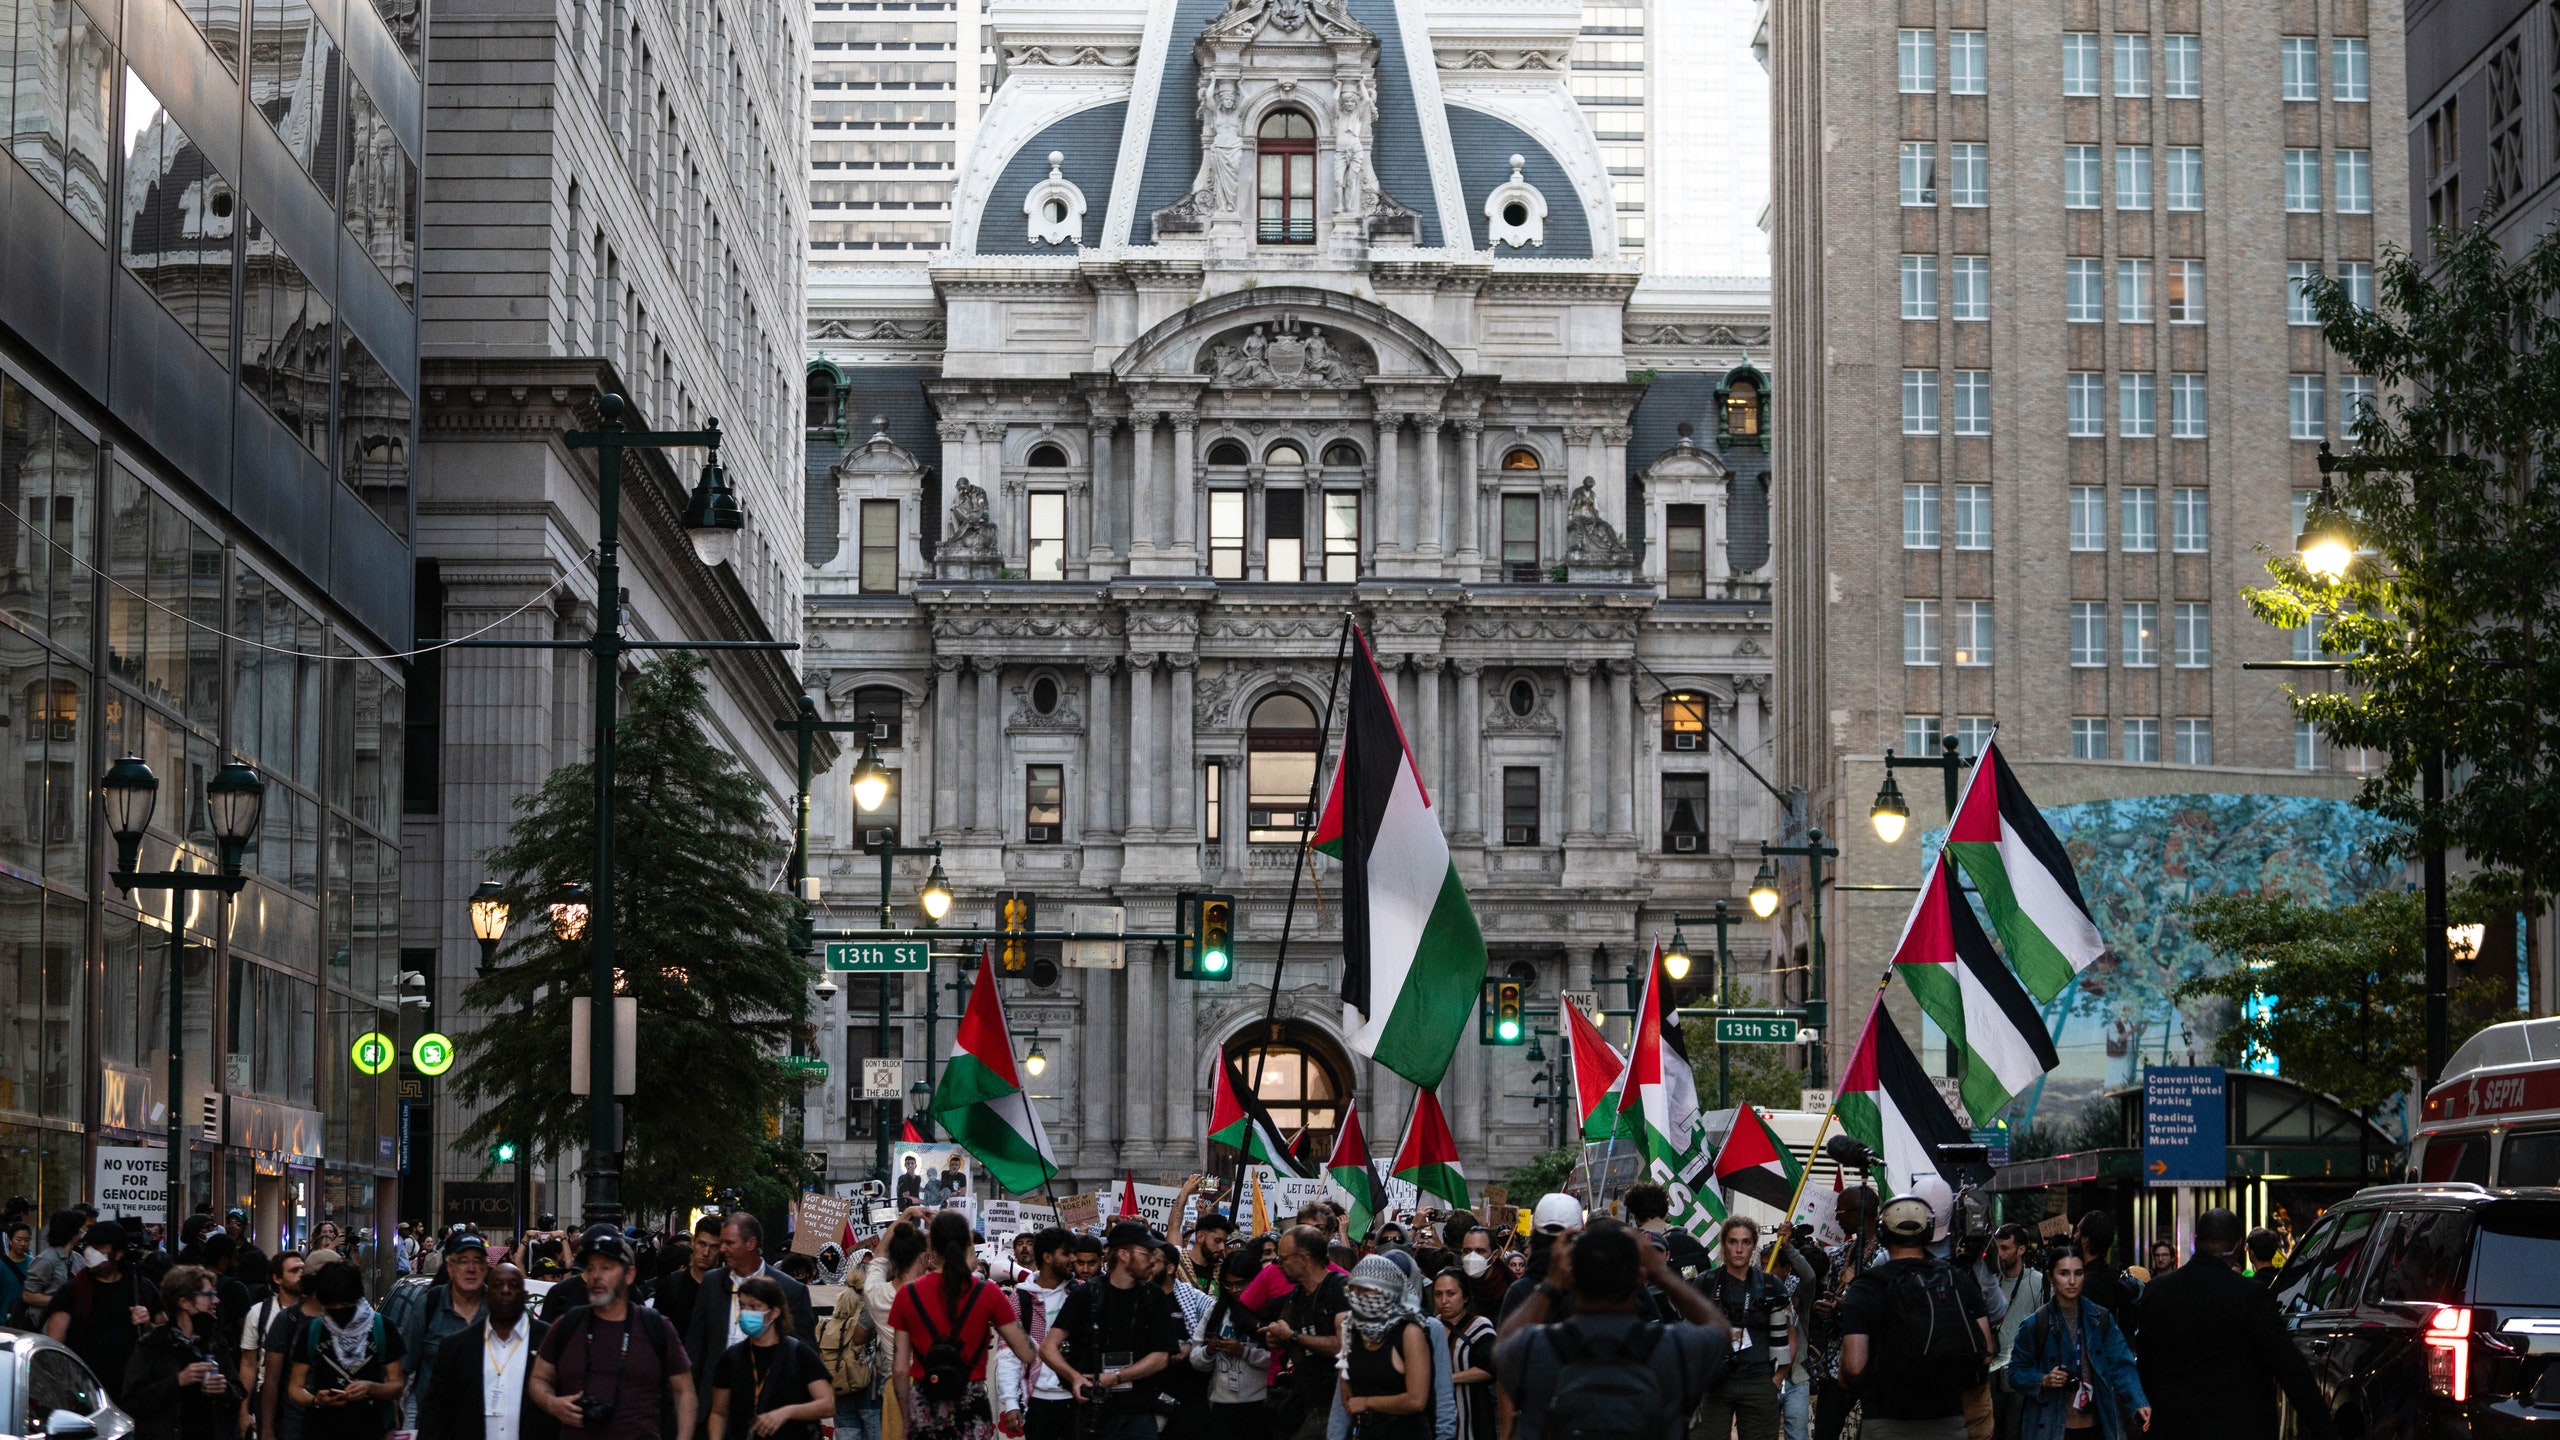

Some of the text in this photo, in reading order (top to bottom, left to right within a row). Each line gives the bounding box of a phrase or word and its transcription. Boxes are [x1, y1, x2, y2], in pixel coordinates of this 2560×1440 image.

[838, 948, 917, 964] 13th St
[1568, 994, 1591, 1005] ONE
[1726, 1024, 1787, 1037] 13th St
[882, 1060, 901, 1068] BLOCK
[2148, 1074, 2212, 1084] Convention
[866, 1089, 900, 1097] THE BOX
[2148, 1086, 2222, 1095] Center Hotel
[2484, 1078, 2526, 1110] SEPTA
[1810, 1093, 1825, 1101] NO
[2149, 1096, 2192, 1107] Parking
[1808, 1102, 1827, 1110] TURN
[1957, 1116, 1970, 1127] OX
[2149, 1113, 2194, 1124] Reading
[2149, 1124, 2197, 1134] Terminal
[2149, 1136, 2189, 1145] Market
[104, 1159, 168, 1172] NO VOTES
[122, 1175, 148, 1186] FOR
[1286, 1183, 1329, 1195] LET GAZA
[103, 1189, 167, 1201] GENOCIDE
[103, 1203, 167, 1212] TAKE THE PLEDGE
[805, 1194, 847, 1210] GOT MONEY
[803, 1203, 847, 1218] FOR WARS BUT
[804, 1212, 839, 1225] CANT FEED
[1031, 1213, 1057, 1223] VOTES
[804, 1220, 834, 1231] THE POOR
[855, 1225, 877, 1236] OTE
[1033, 1222, 1044, 1230] OR
